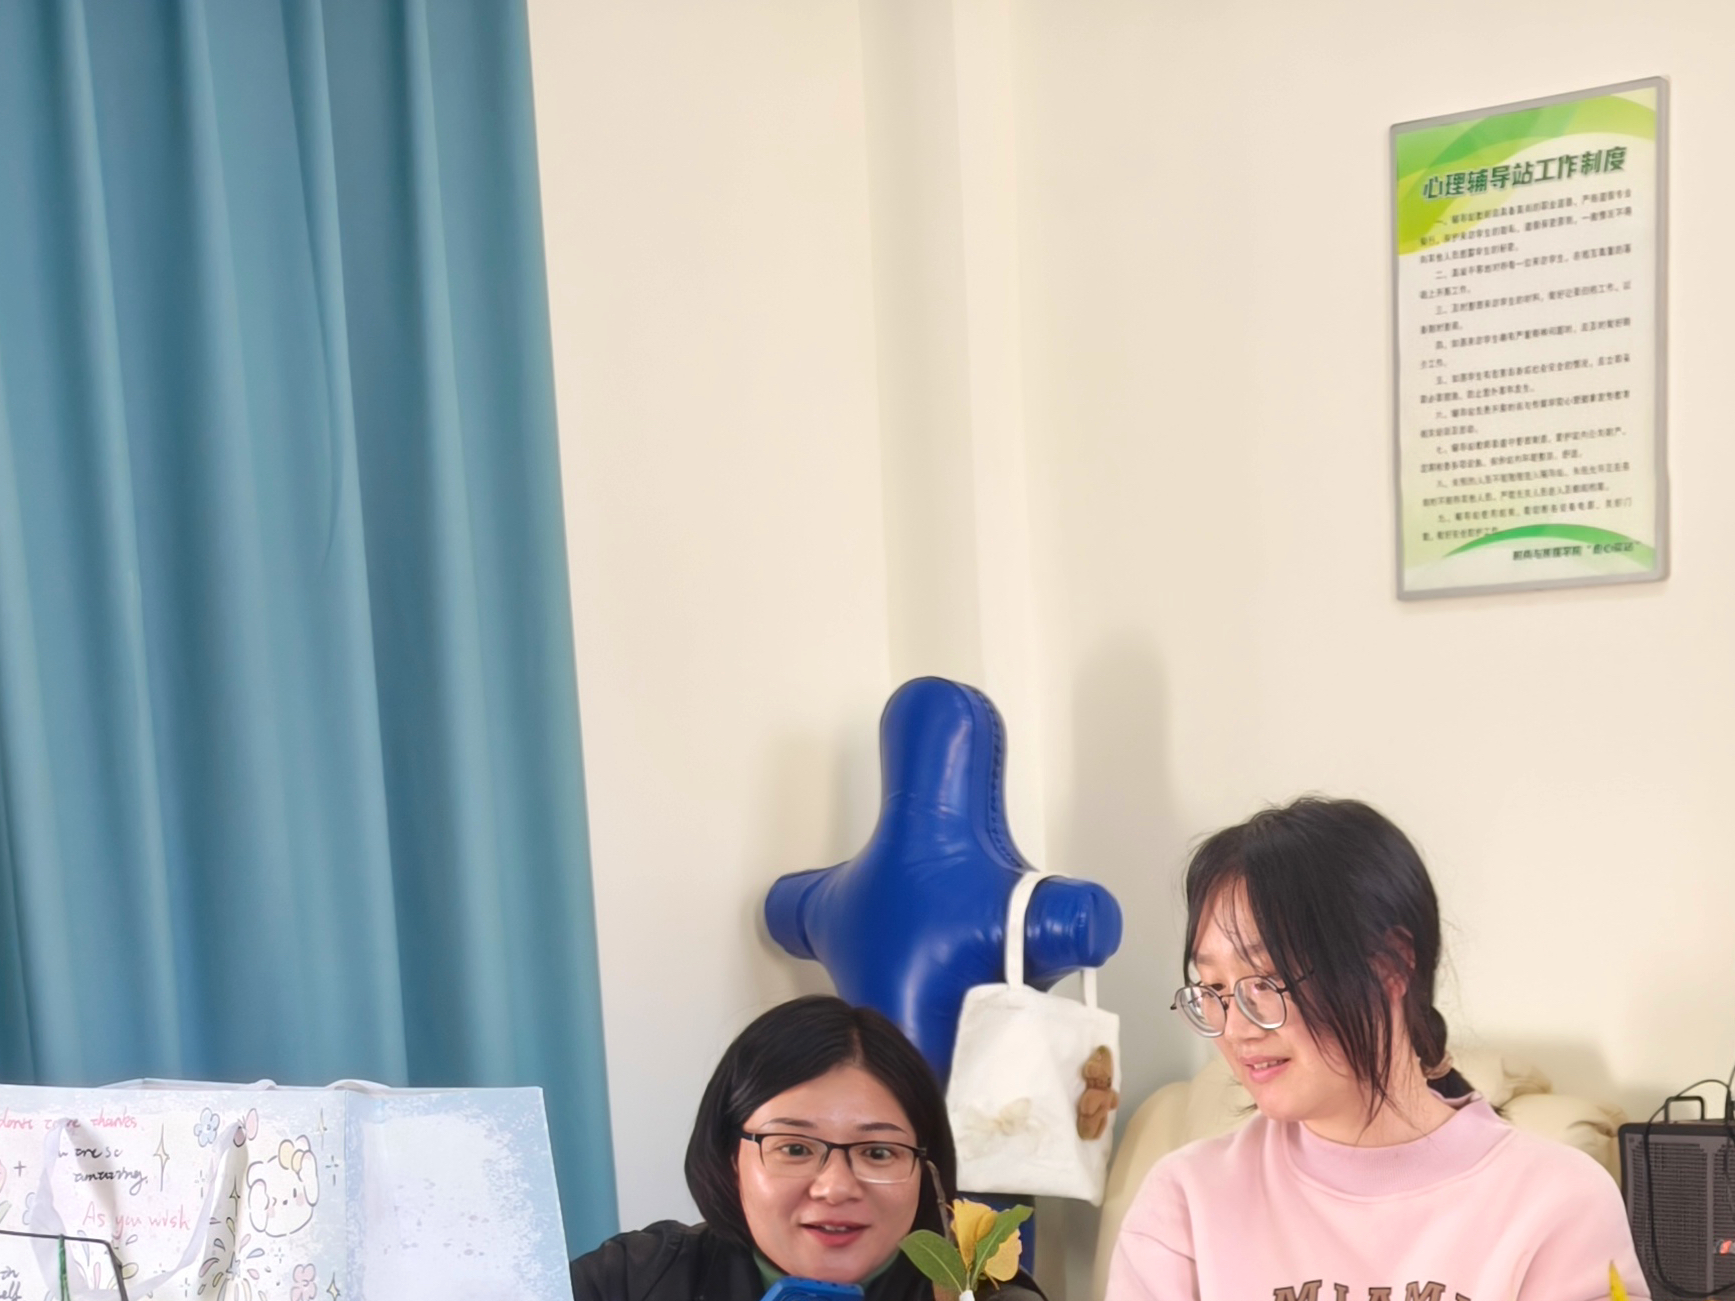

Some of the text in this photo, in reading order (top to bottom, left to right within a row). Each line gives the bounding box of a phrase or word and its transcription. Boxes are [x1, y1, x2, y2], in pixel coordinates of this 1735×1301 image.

[1423, 146, 1627, 199] 心理辅导站工作制度
[83, 1201, 106, 1227] As
[149, 1204, 190, 1230] wish
